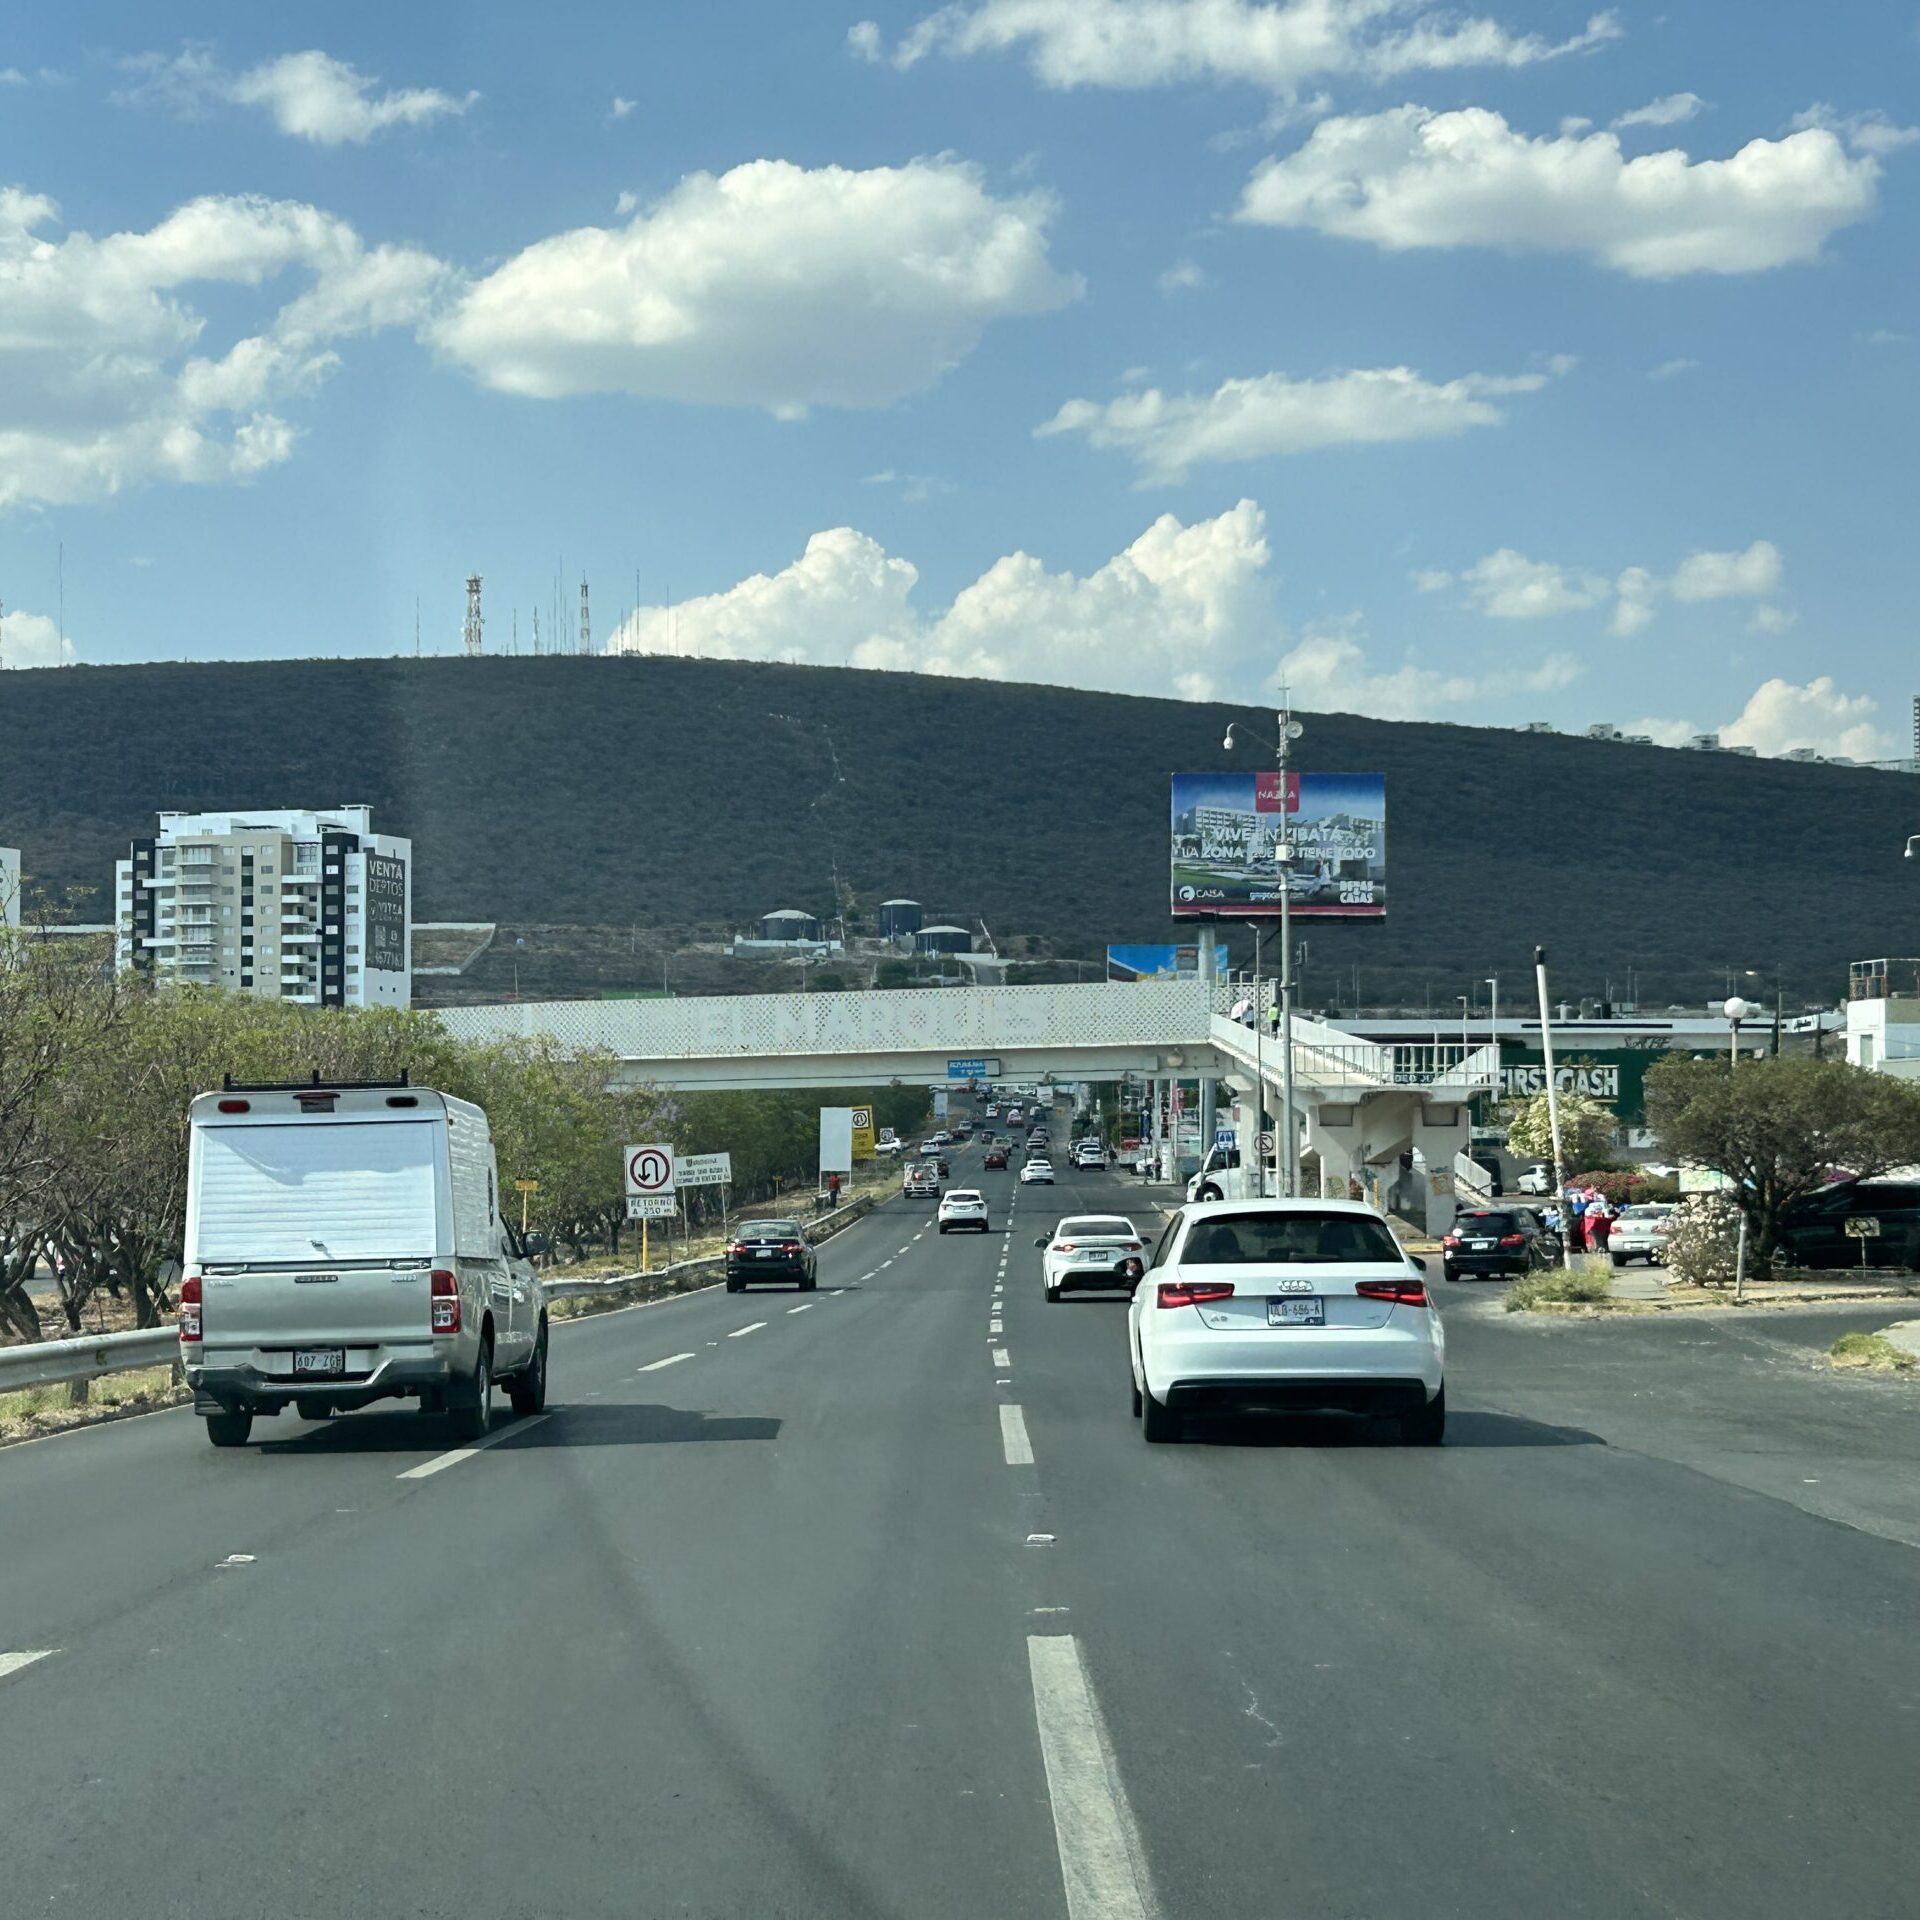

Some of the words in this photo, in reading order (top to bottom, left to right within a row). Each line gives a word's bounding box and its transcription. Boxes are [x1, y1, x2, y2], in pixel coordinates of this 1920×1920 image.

[1214, 827, 1251, 841] VIVE
[1201, 847, 1244, 858] ZONA
[1297, 847, 1334, 858] TIENE
[1335, 847, 1376, 859] TODO
[369, 860, 403, 880] VENTA
[369, 878, 404, 896] DEPTOS
[1555, 1068, 1619, 1096] CASH
[630, 1198, 672, 1207] RETORNO
[632, 1207, 639, 1215] A
